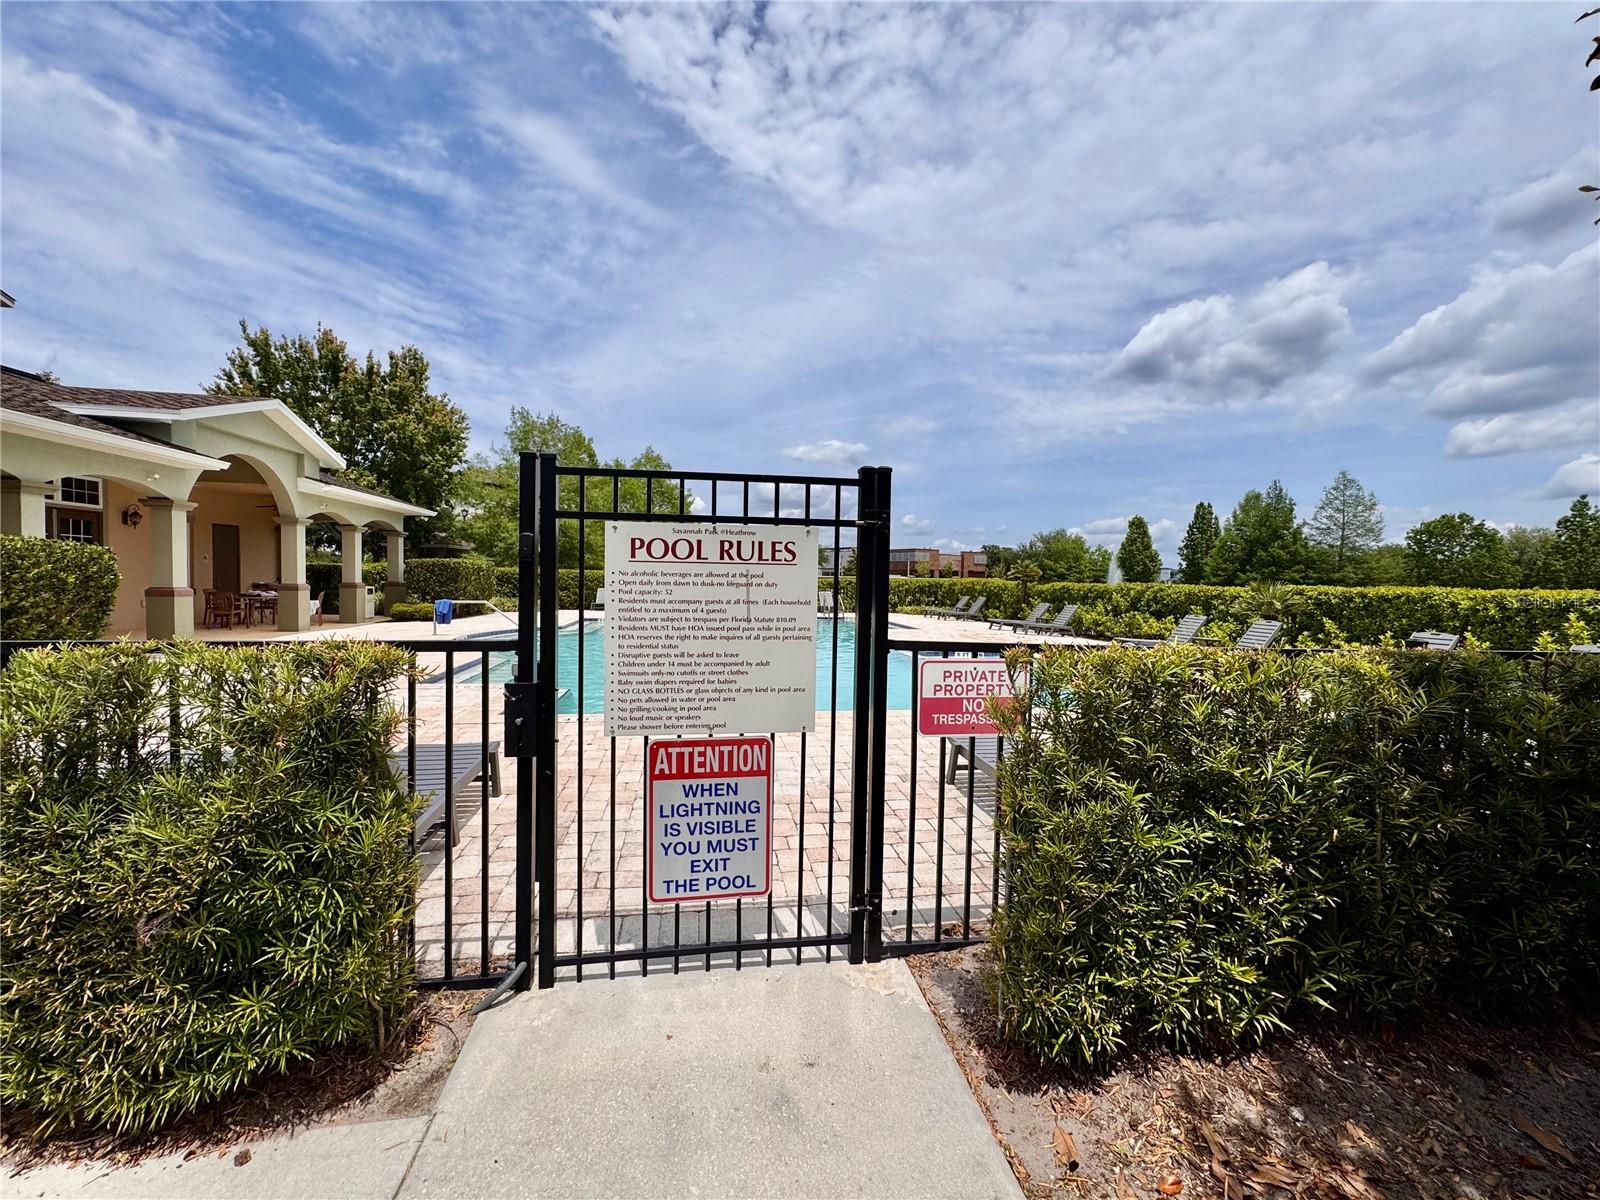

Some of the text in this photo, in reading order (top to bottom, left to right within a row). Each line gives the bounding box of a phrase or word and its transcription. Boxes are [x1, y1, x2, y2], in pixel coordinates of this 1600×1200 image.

[629, 538, 797, 563] POOL RULES
[660, 570, 691, 578] beverages
[943, 670, 1006, 682] PRIVATE
[933, 684, 1014, 696] PROPERTY
[629, 705, 677, 713] grilling/cooking
[962, 698, 984, 712] NO
[932, 714, 1001, 725] TRESPASS
[654, 744, 766, 774] ATTENTION
[682, 782, 738, 798] WHEN
[660, 800, 760, 818] LIGHTNING
[664, 819, 756, 837] IS VISIBLE
[660, 838, 759, 856] YOU MUST
[690, 858, 730, 874] EXIT
[662, 875, 756, 894] THE POOL
